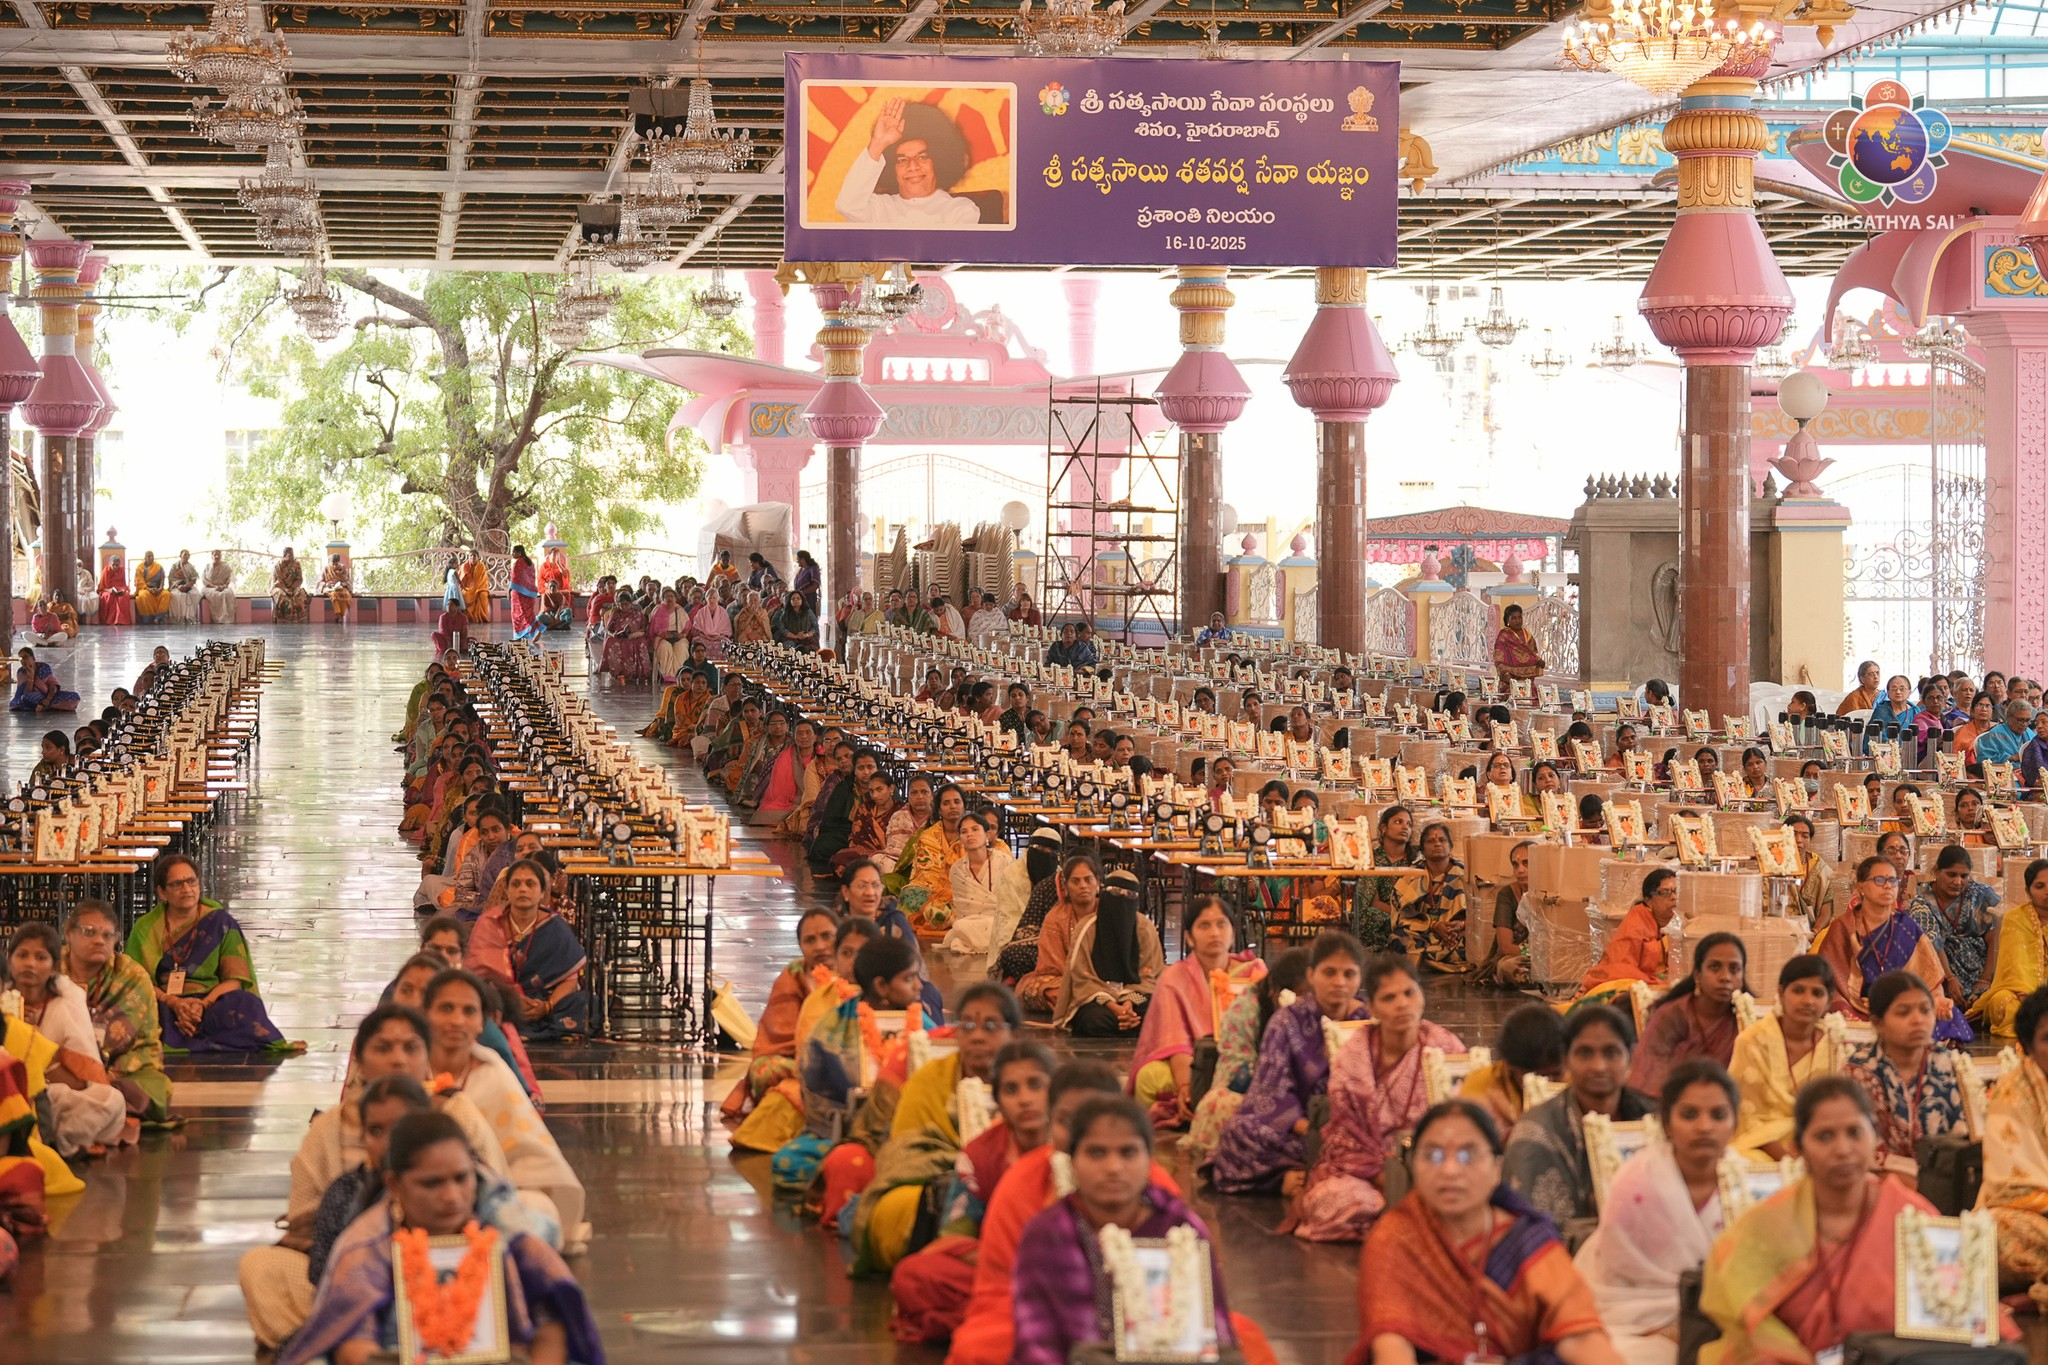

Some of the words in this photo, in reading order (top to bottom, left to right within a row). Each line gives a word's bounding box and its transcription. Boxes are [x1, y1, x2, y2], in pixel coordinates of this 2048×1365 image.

[1079, 88, 1104, 114] శ్రీ
[1108, 90, 1207, 117] సత్యసాయి
[1210, 90, 1255, 112] సేవా
[1259, 92, 1335, 123] సంస్థలు
[1134, 120, 1182, 139] శివం,
[1185, 120, 1280, 142] హైదరాబాద్
[1042, 153, 1064, 188] శ్రీ
[1071, 155, 1169, 195] సత్యసాయి
[1175, 157, 1250, 196] శతవర్ష
[1255, 154, 1299, 185] సేవా
[1306, 159, 1370, 201] యజ్ఞం
[1136, 205, 1202, 228] ప్రశాంతి
[1205, 207, 1276, 224] నిలయం
[1165, 235, 1247, 251] 16-10-2025
[616, 892, 652, 903] VIDYA
[627, 909, 664, 920] VIDYA
[641, 925, 682, 937] VIDYA
